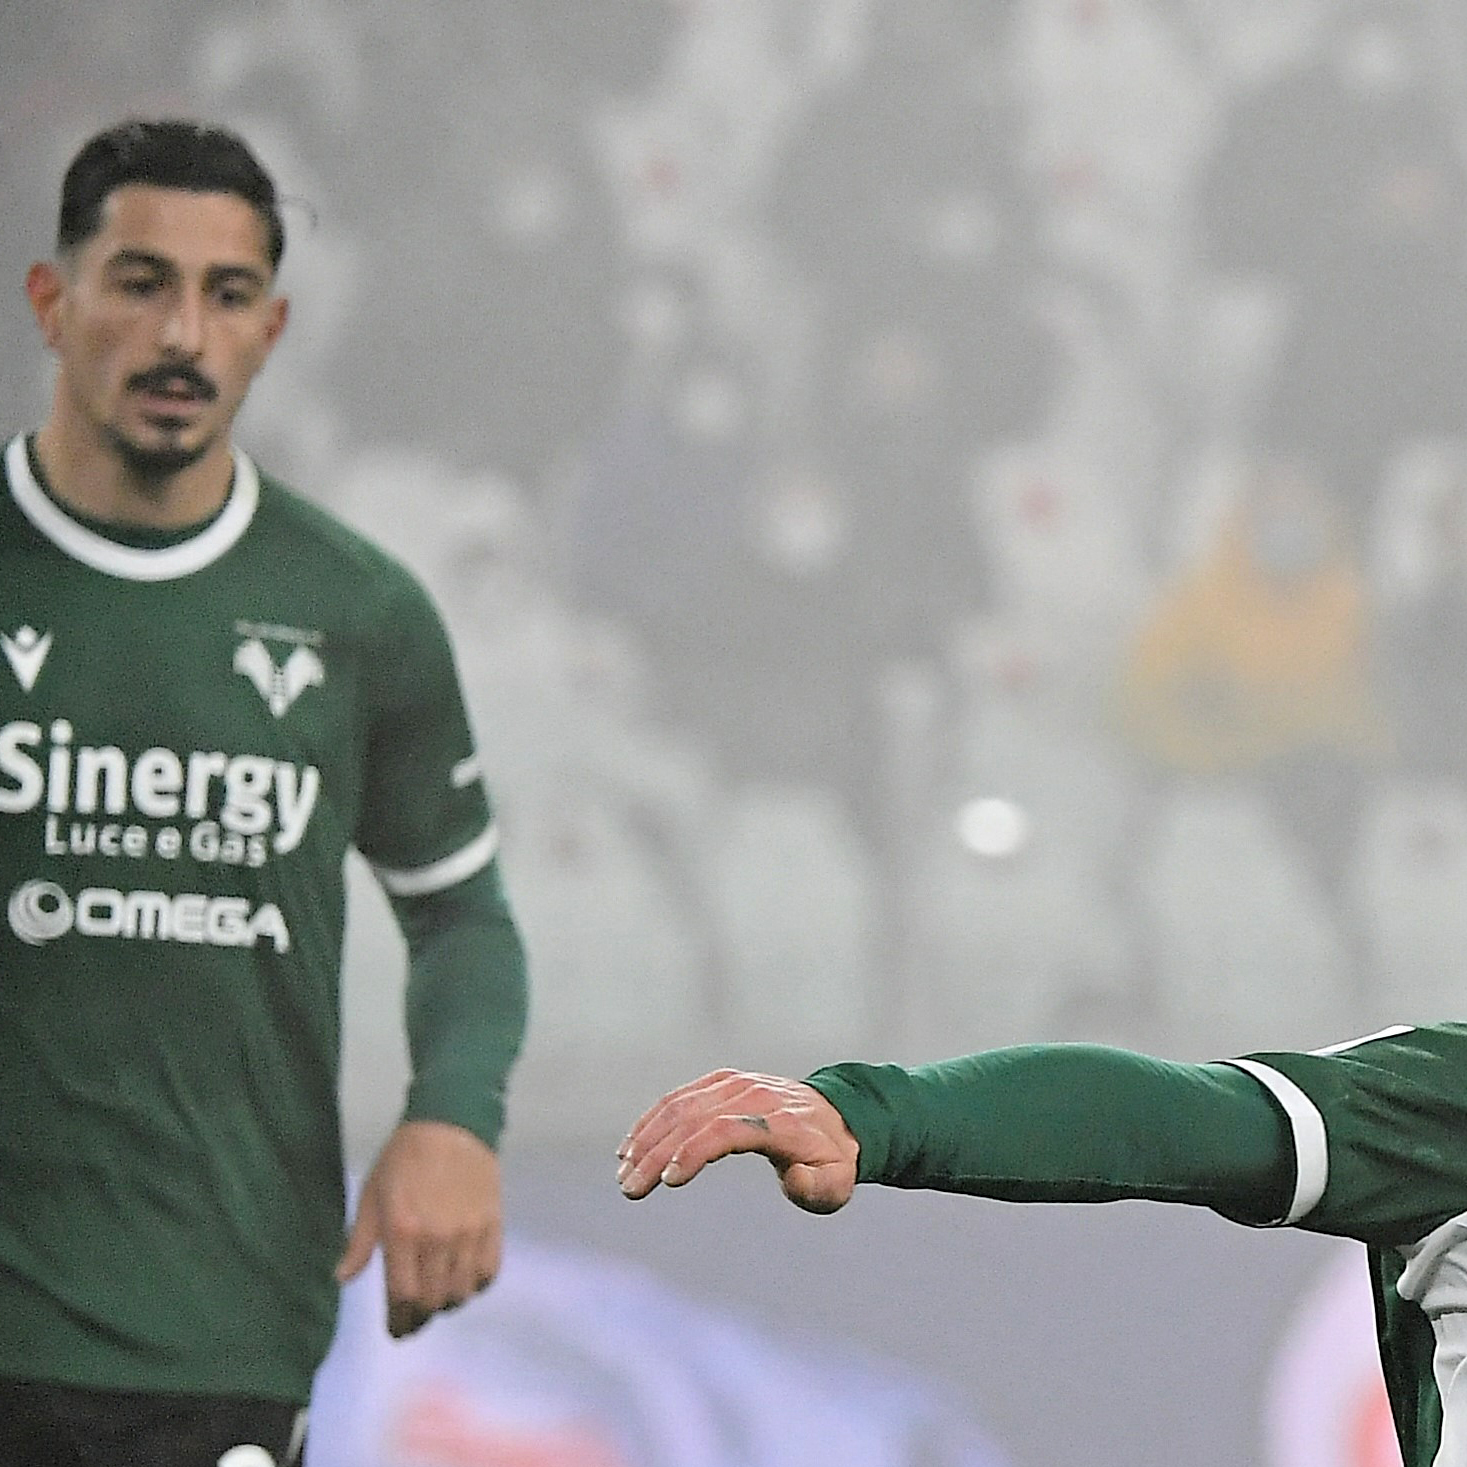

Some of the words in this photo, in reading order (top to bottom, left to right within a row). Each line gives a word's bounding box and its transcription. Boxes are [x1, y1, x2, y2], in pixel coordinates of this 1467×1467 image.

[0, 718, 320, 855] Sinergy
[45, 813, 148, 858] Luce
[155, 826, 183, 860] e
[189, 820, 267, 869] Gas
[76, 886, 290, 954] OMEGA
